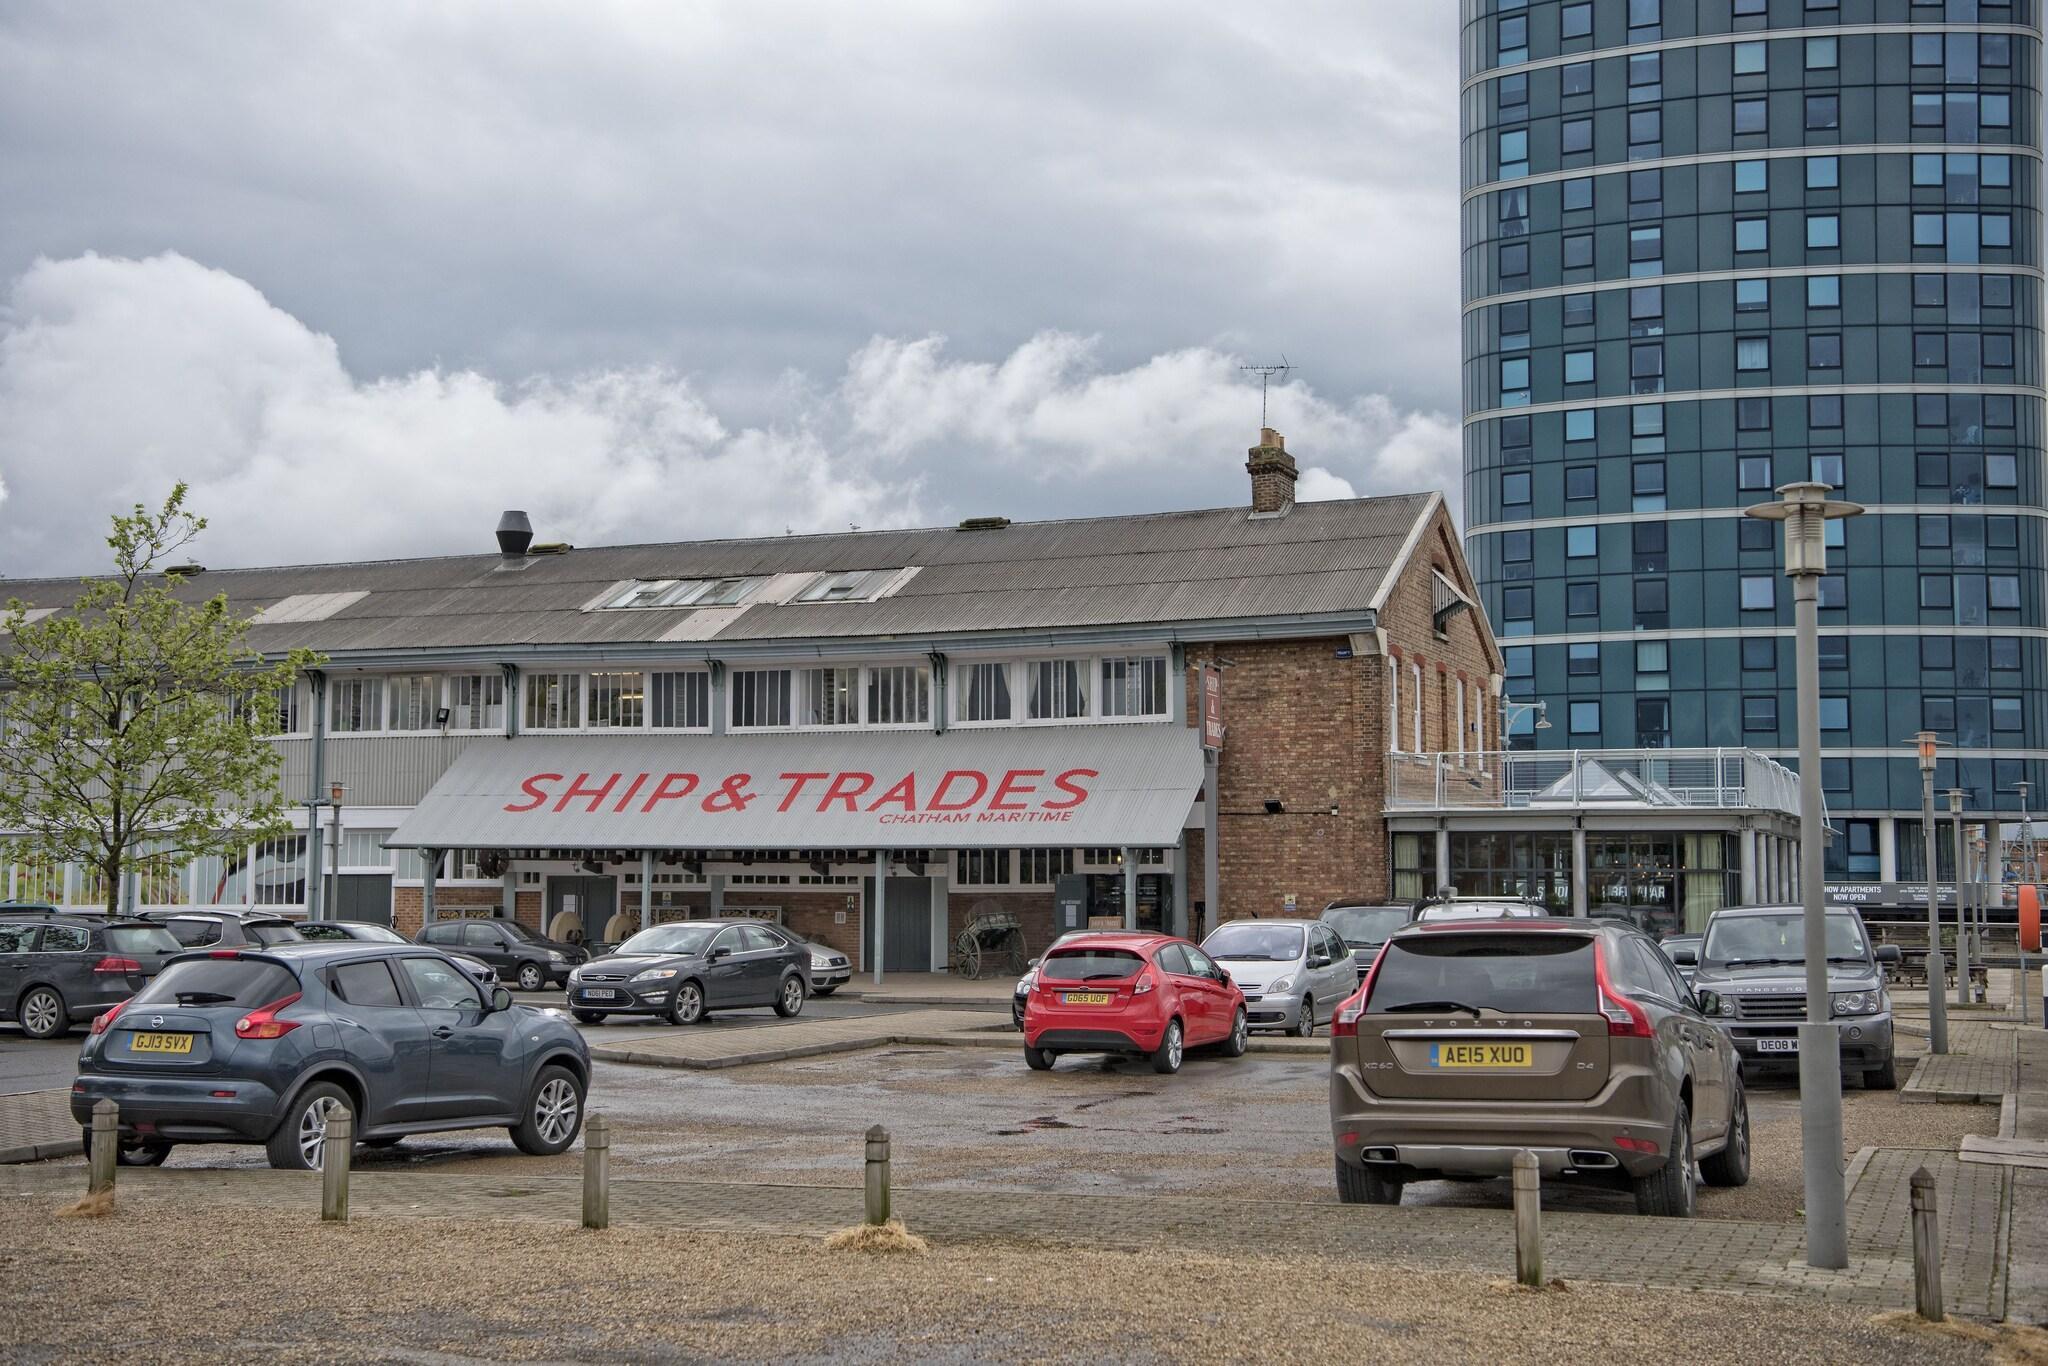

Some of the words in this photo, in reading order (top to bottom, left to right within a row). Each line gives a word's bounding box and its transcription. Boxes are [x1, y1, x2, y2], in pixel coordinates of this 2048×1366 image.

[503, 772, 700, 813] SHIP
[701, 773, 757, 813] &
[776, 768, 1099, 813] TRADES
[879, 812, 970, 825] CHATHAM
[976, 810, 1075, 823] MARITIME
[1833, 893, 1849, 901] NOW
[1850, 893, 1867, 901] OPEN
[136, 1034, 162, 1049] GJ13
[164, 1035, 189, 1050] SVX
[1760, 1040, 1788, 1050] DE08
[1445, 1047, 1485, 1064] AE15
[1489, 1047, 1525, 1063] XUO
[1576, 1062, 1595, 1070] D4
